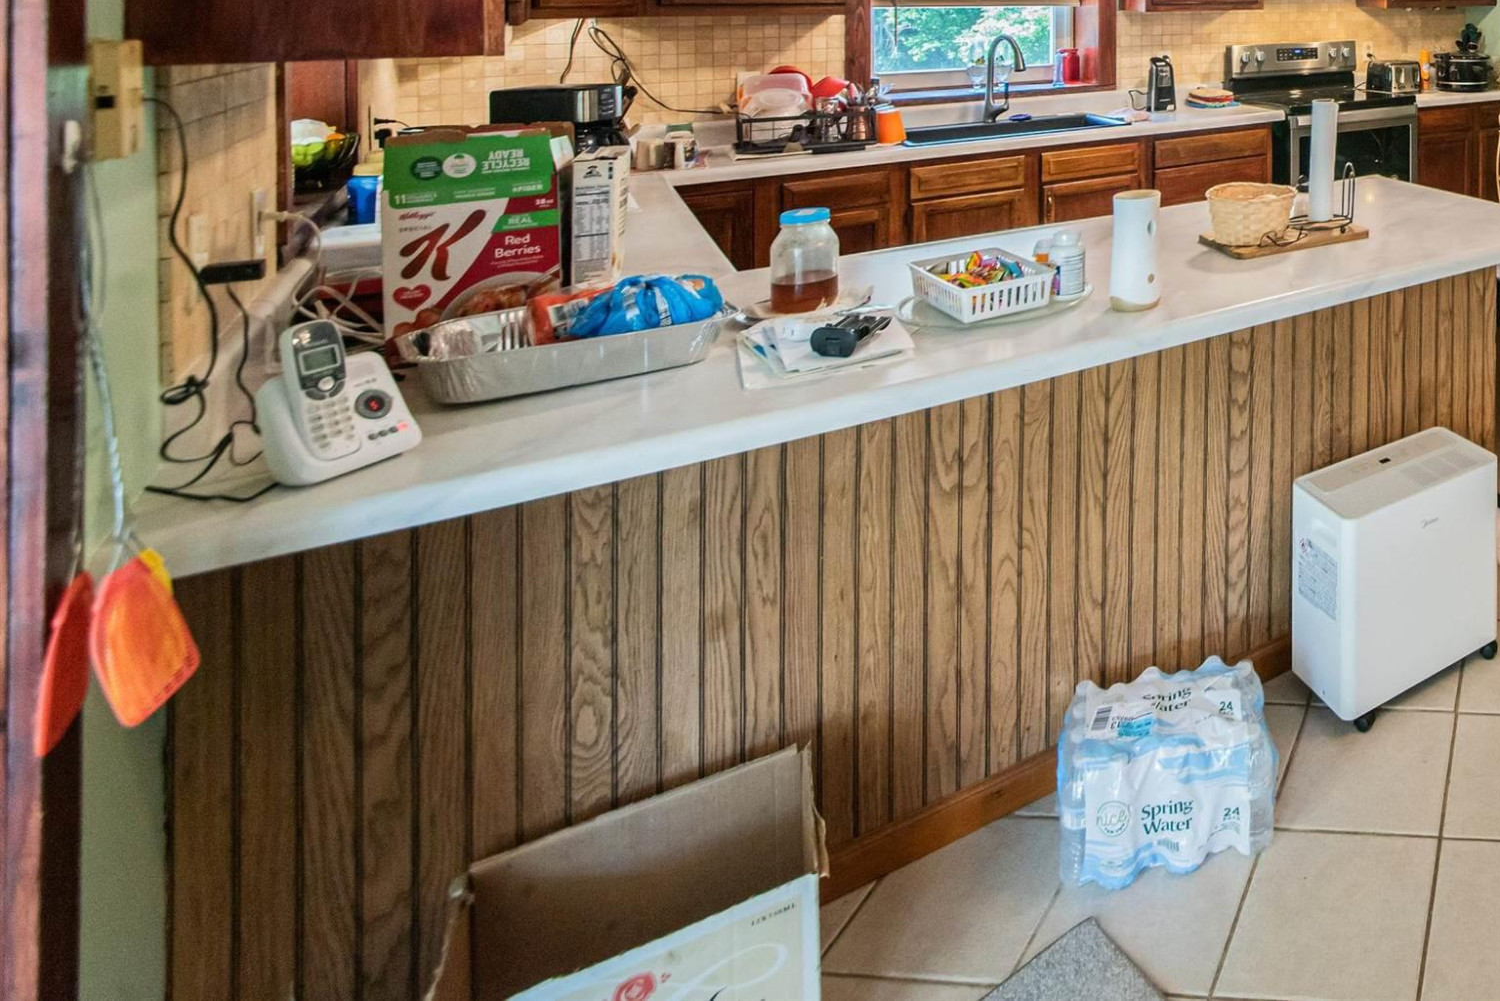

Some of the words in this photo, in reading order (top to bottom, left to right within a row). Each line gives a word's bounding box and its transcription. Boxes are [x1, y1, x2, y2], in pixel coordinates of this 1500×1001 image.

[488, 148, 524, 160] READY
[481, 157, 530, 170] RECYCLE
[398, 209, 487, 281] K
[504, 234, 531, 246] Red
[494, 245, 542, 259] Berries
[1218, 701, 1233, 712] 24
[1141, 799, 1194, 821] Spring
[1223, 807, 1241, 817] 24
[1143, 816, 1193, 835] Water
